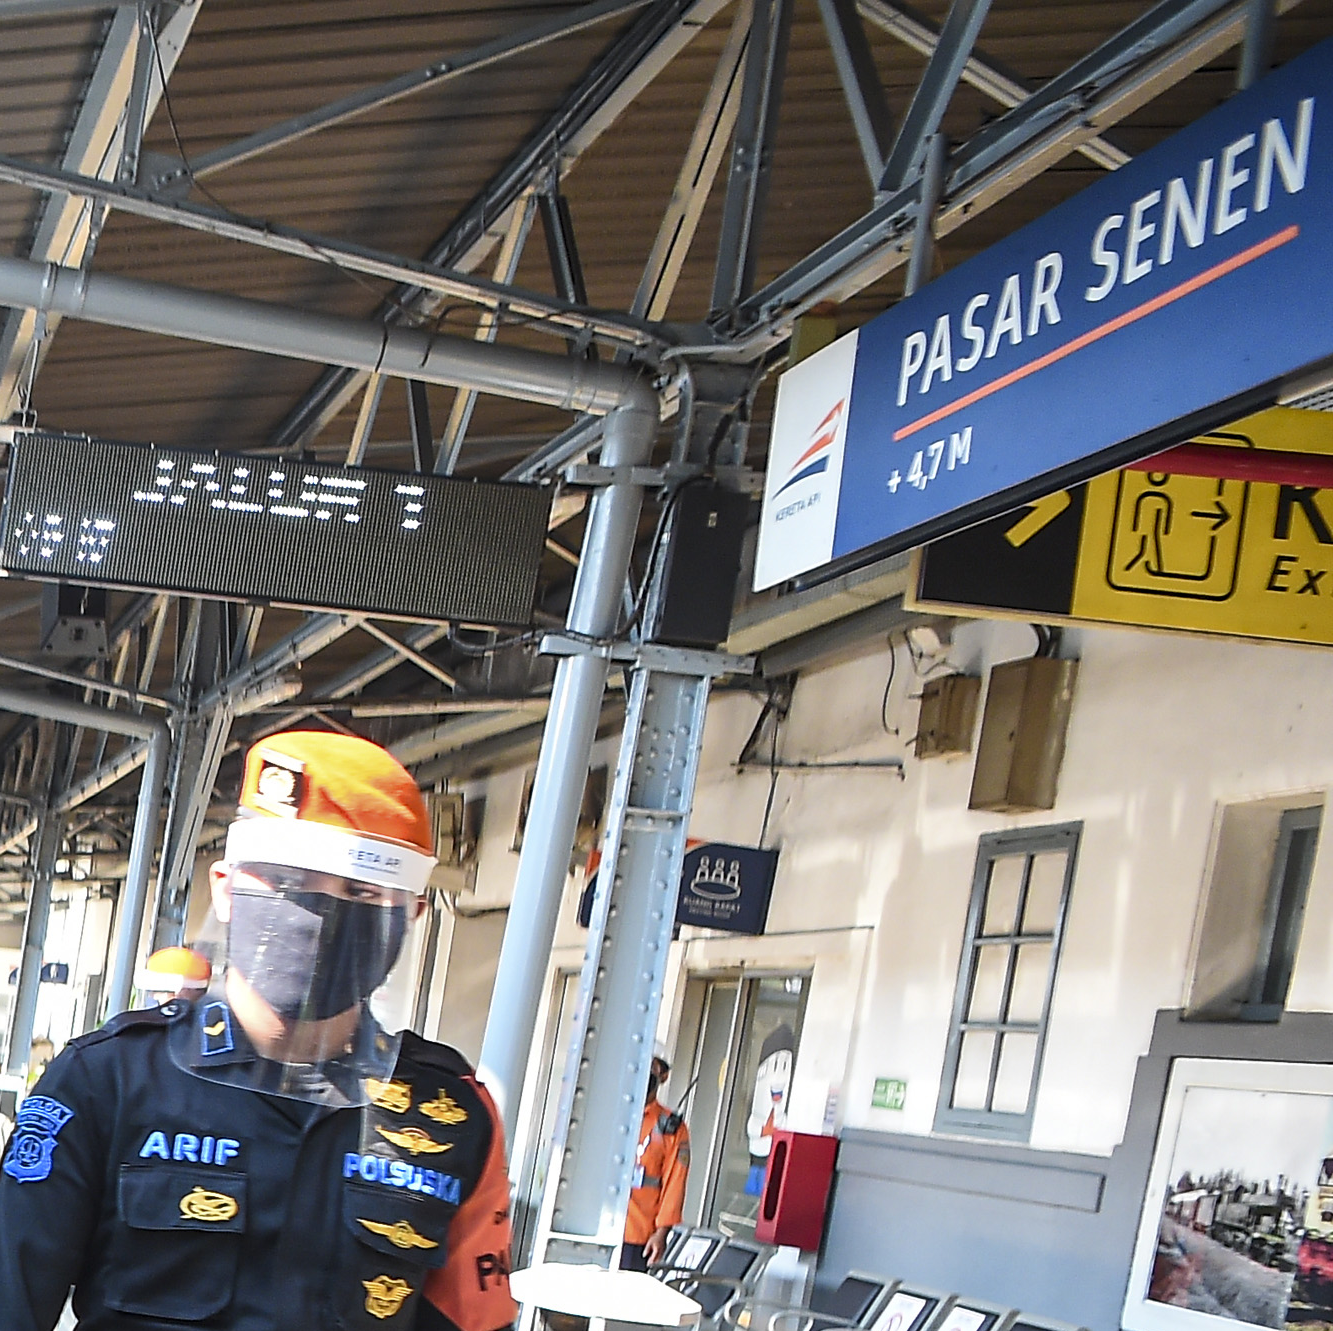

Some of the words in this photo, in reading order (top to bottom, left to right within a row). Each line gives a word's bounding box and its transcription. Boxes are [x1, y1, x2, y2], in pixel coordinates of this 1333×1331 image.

[896, 252, 1063, 407] PASAR
[1085, 97, 1315, 301] SENEN
[139, 1131, 240, 1166] ARIF
